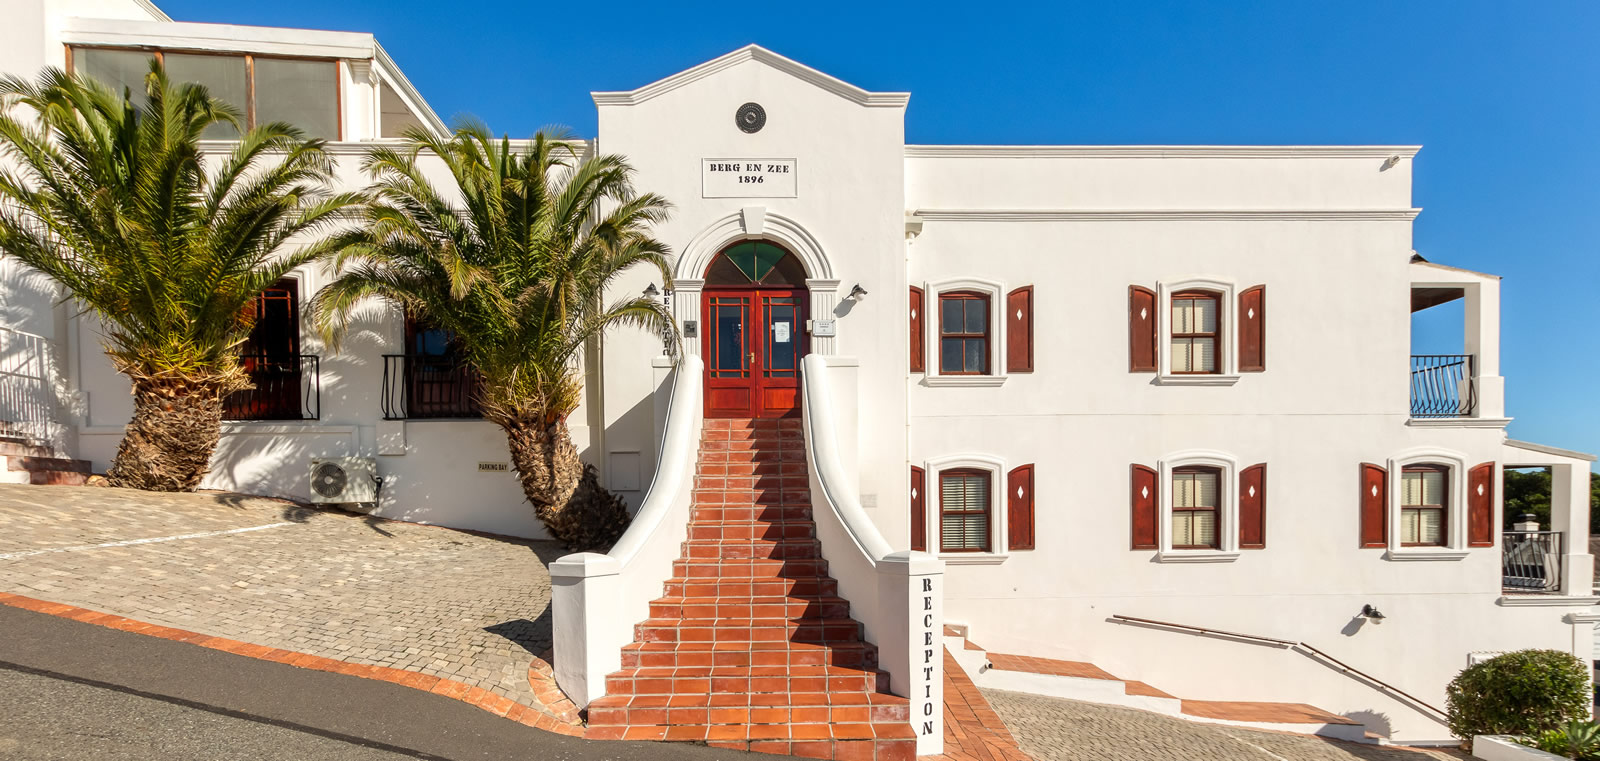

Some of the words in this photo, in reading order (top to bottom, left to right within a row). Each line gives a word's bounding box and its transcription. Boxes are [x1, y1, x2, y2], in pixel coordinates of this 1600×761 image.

[710, 163, 740, 172] BERG
[746, 163, 761, 172] EN
[767, 164, 789, 173] ZEE
[738, 175, 764, 184] 1896
[922, 578, 933, 735] RECEPTION
